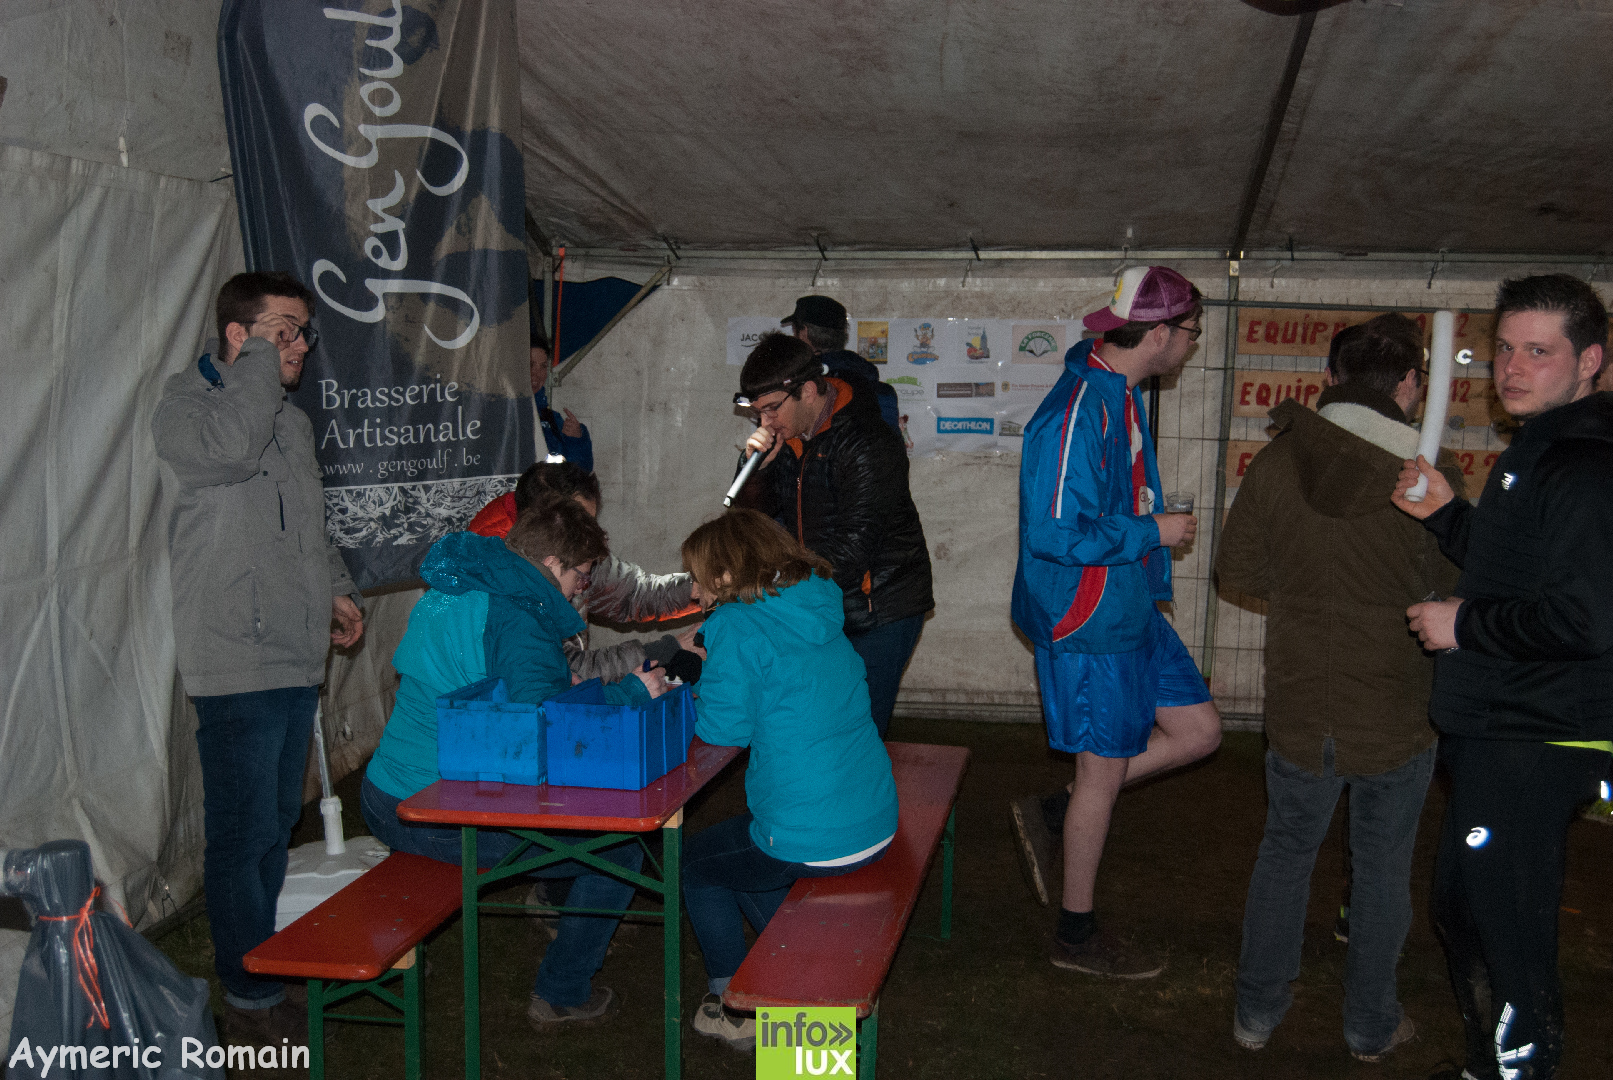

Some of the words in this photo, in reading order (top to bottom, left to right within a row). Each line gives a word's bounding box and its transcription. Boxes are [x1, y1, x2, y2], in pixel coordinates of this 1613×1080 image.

[318, 374, 460, 410] Brasserie
[321, 406, 482, 450] Artisanale
[940, 420, 990, 431] DECATHLON
